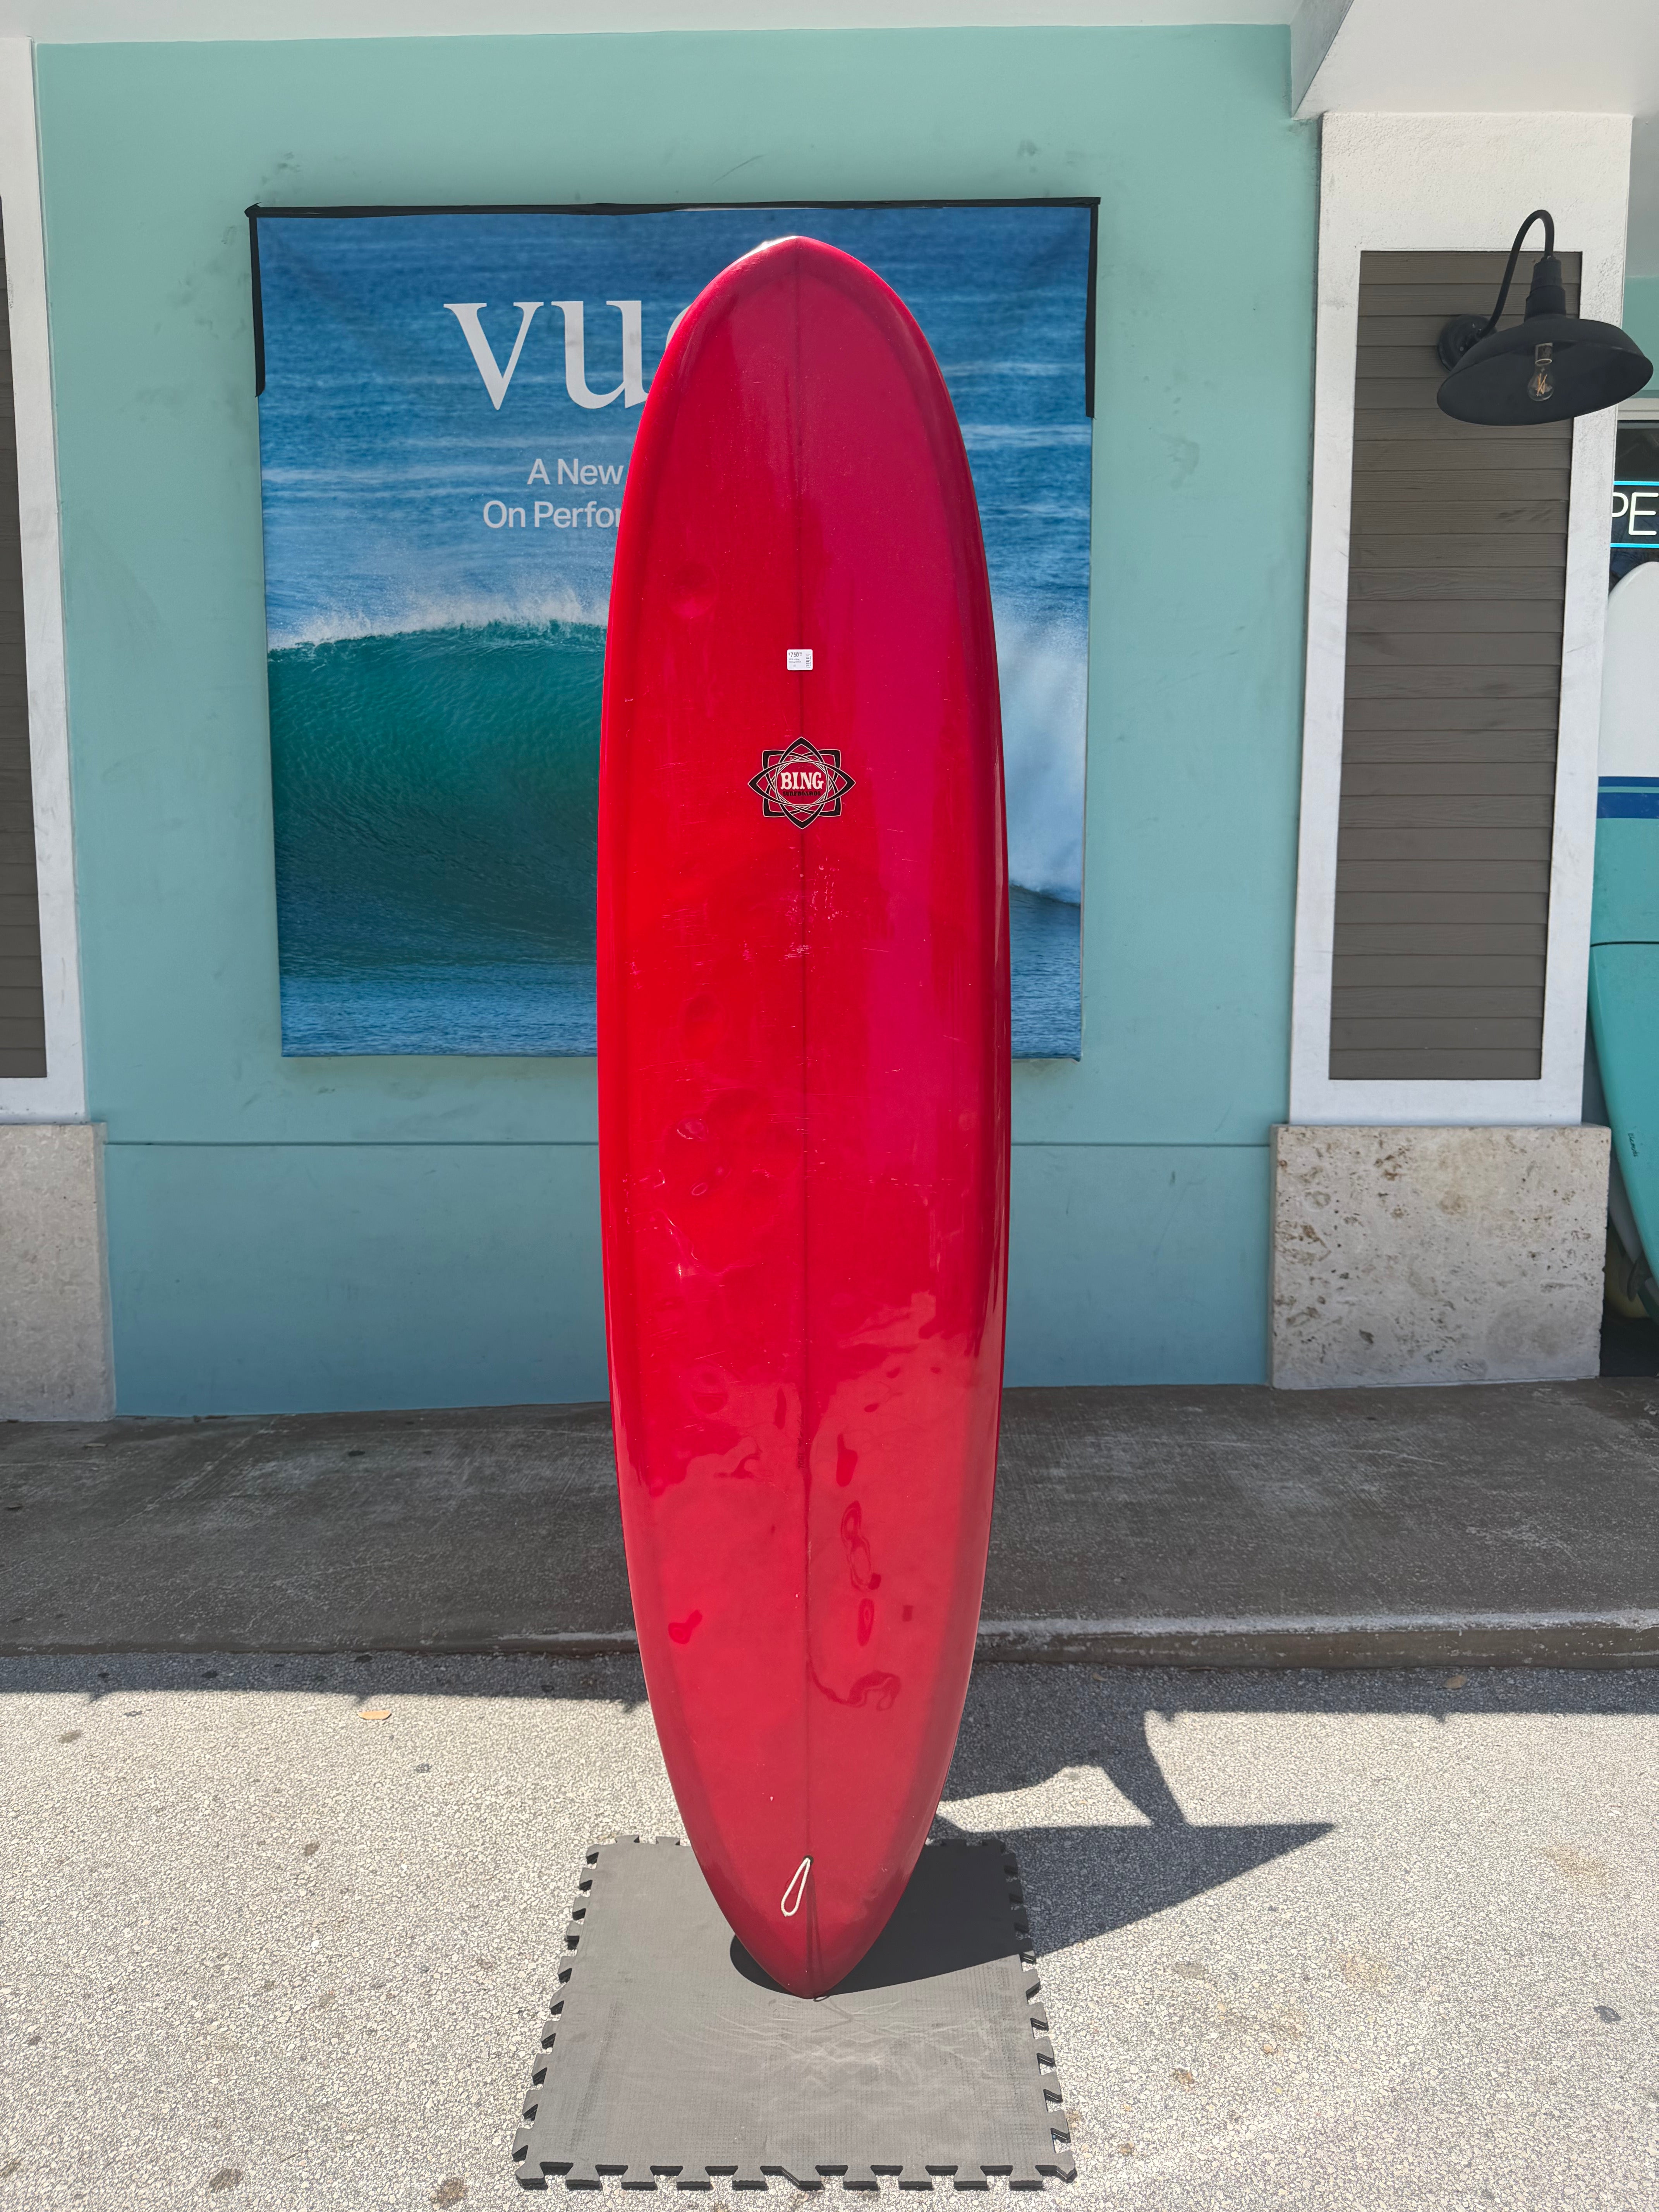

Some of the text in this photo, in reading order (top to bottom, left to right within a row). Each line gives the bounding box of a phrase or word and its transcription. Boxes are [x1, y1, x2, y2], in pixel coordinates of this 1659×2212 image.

[443, 300, 691, 410] vu
[527, 459, 624, 485] A New
[483, 500, 526, 528] On
[780, 771, 824, 790] BING
